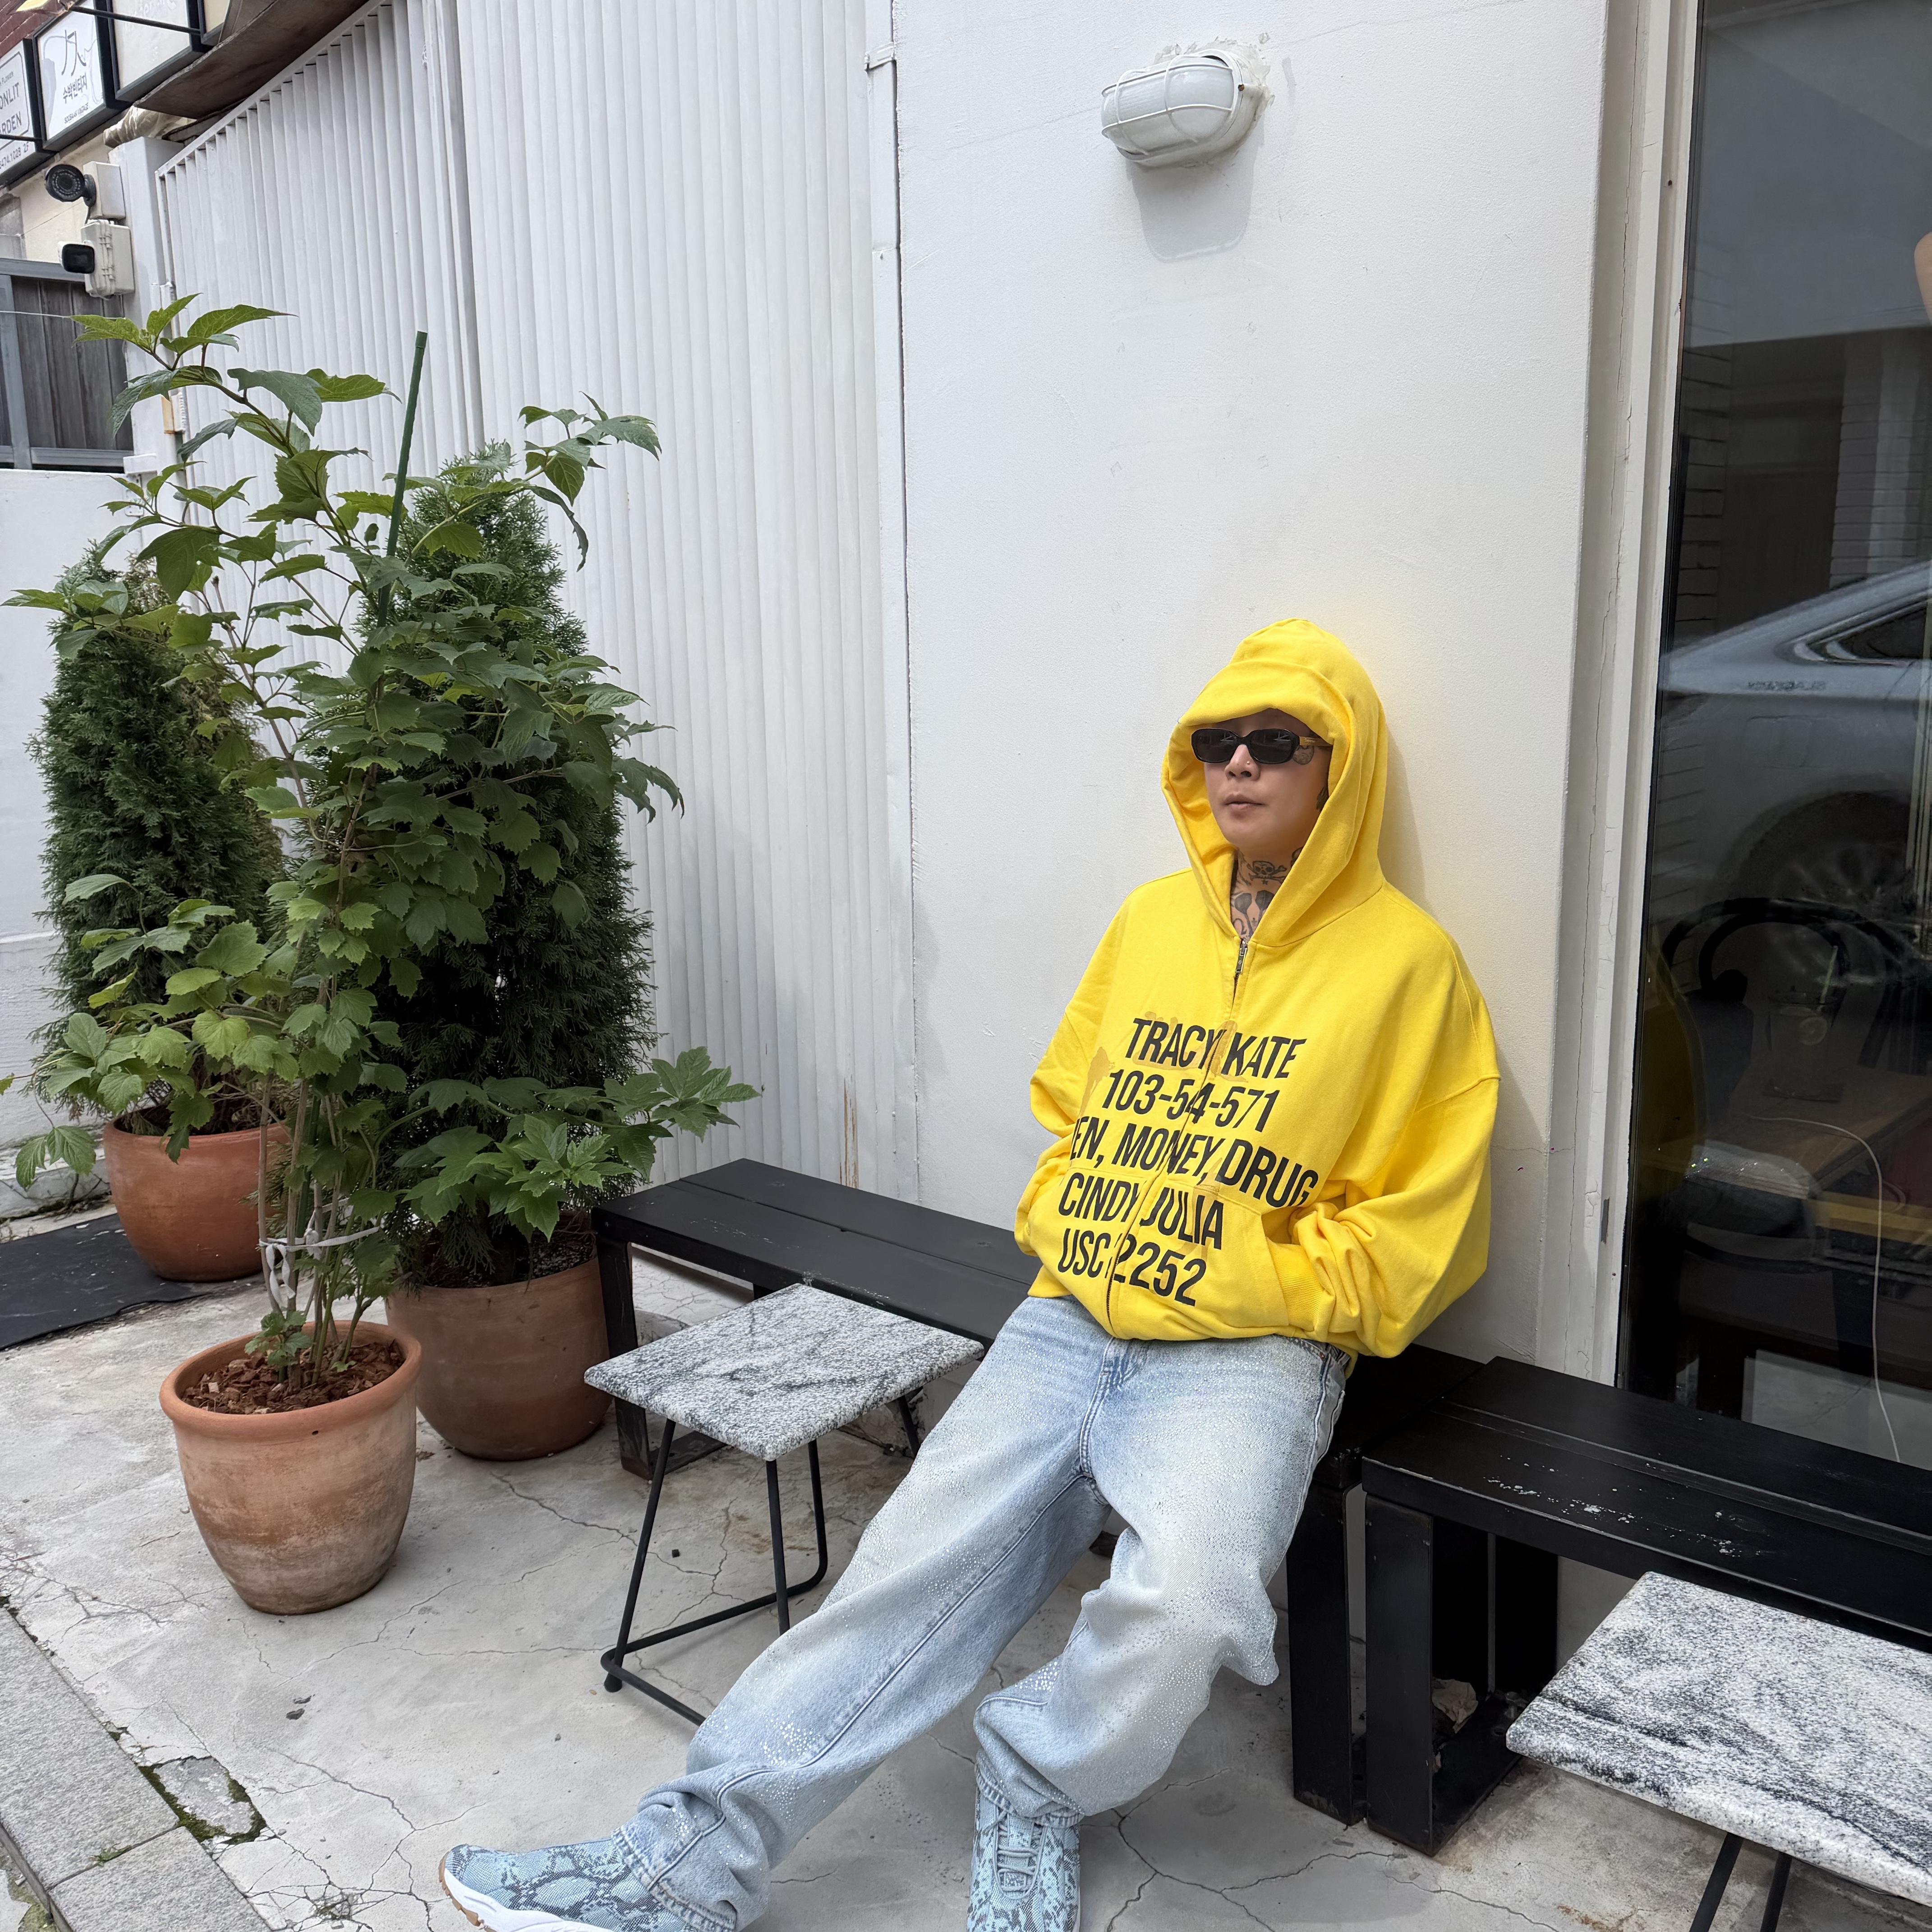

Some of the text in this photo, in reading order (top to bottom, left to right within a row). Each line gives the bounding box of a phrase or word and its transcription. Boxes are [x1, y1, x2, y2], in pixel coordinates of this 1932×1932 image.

[63, 72, 87, 104] 수박빈티지
[0, 111, 22, 134] RDEN
[1125, 1017, 1308, 1079] TRACY KATE
[1101, 1068, 1280, 1133] 103-54-571
[1111, 1122, 1226, 1186] MONEY,
[1214, 1138, 1319, 1208] DRUG
[1058, 1172, 1224, 1250] CINDY JULIA
[1058, 1228, 1206, 1306] USC 2252
